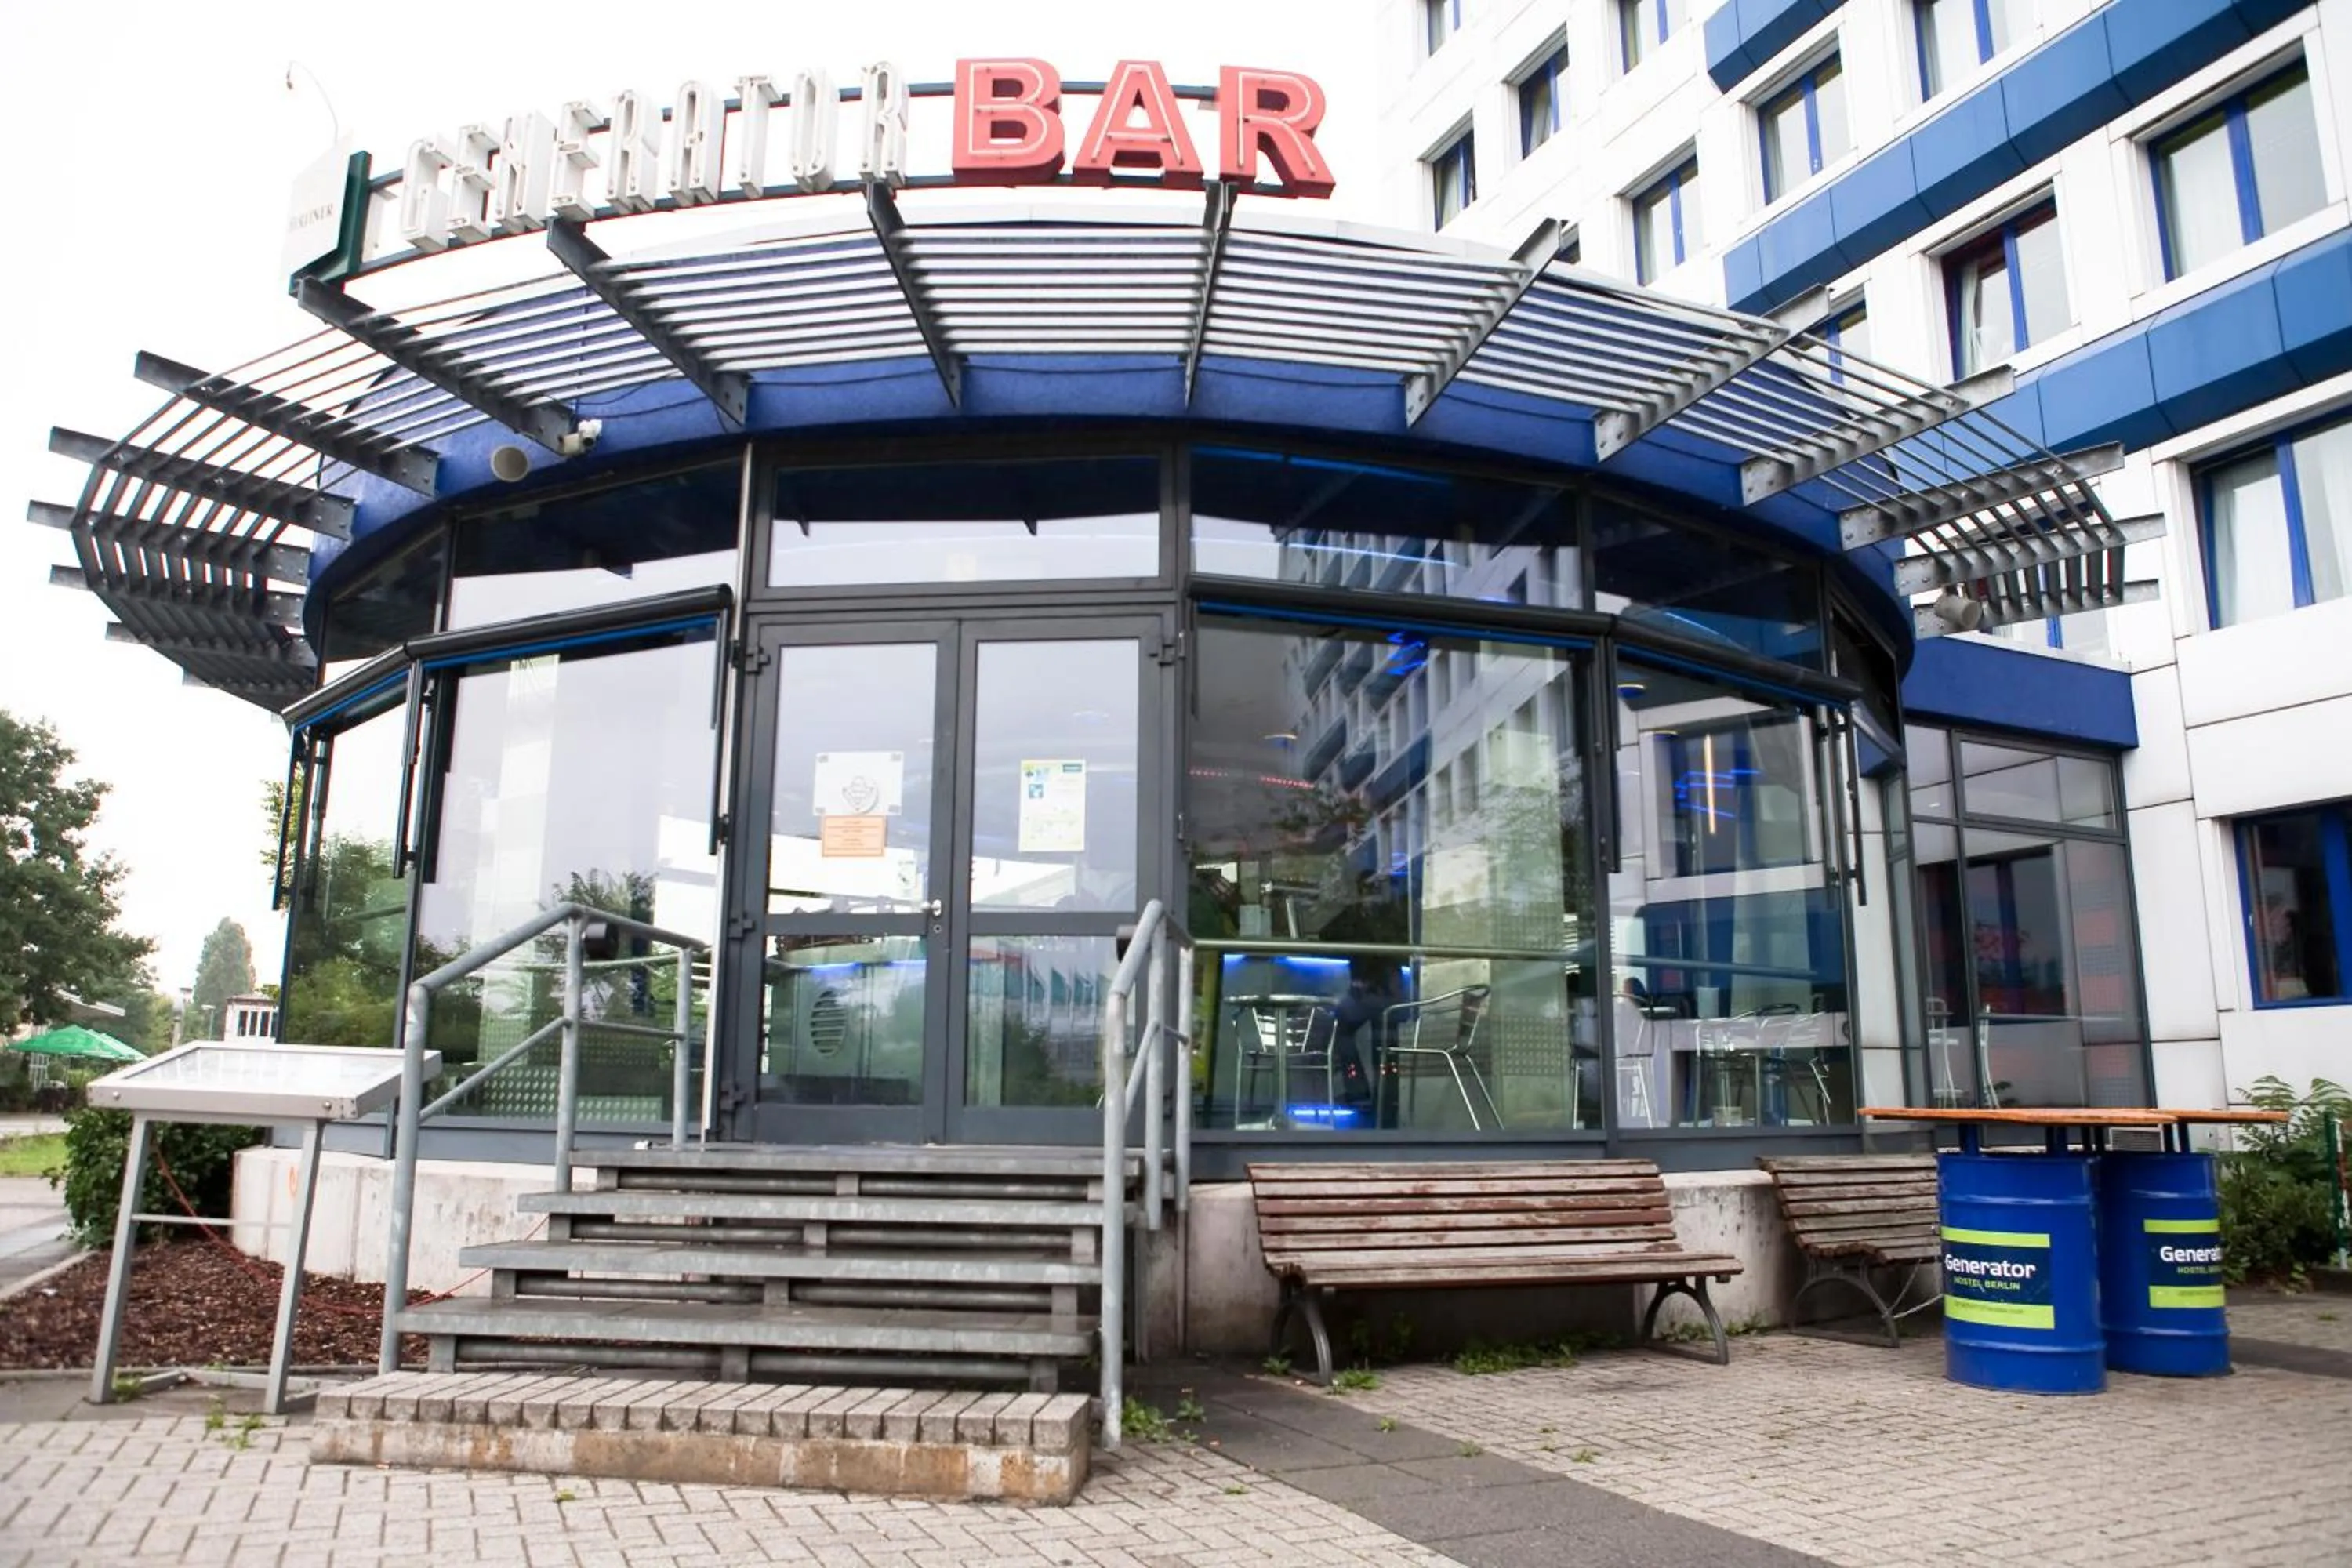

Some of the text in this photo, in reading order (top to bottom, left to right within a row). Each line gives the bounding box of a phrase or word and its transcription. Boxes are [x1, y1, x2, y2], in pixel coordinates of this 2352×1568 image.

[401, 58, 1336, 251] GENERATOR BAR
[1945, 1254, 2036, 1278] Generator
[1953, 1276, 2020, 1290] HOSTEL BERLIN
